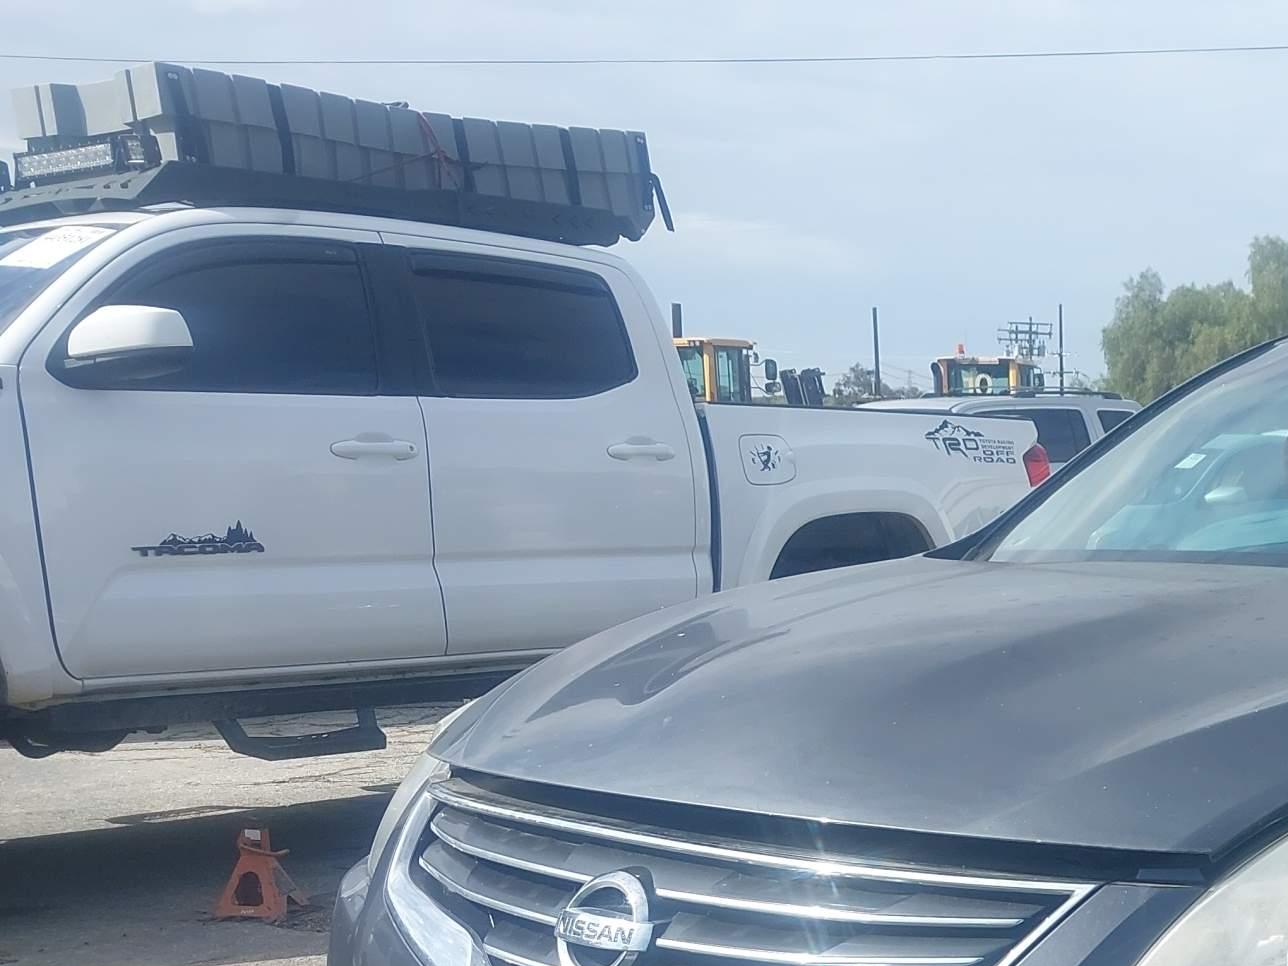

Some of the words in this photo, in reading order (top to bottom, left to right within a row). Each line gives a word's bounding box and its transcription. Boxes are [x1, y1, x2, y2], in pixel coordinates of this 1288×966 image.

[925, 436, 980, 458] TRD
[983, 449, 1015, 457] OFF
[973, 456, 1016, 464] ROAD
[131, 541, 265, 557] TACOMA
[559, 914, 635, 945] NISSAN
